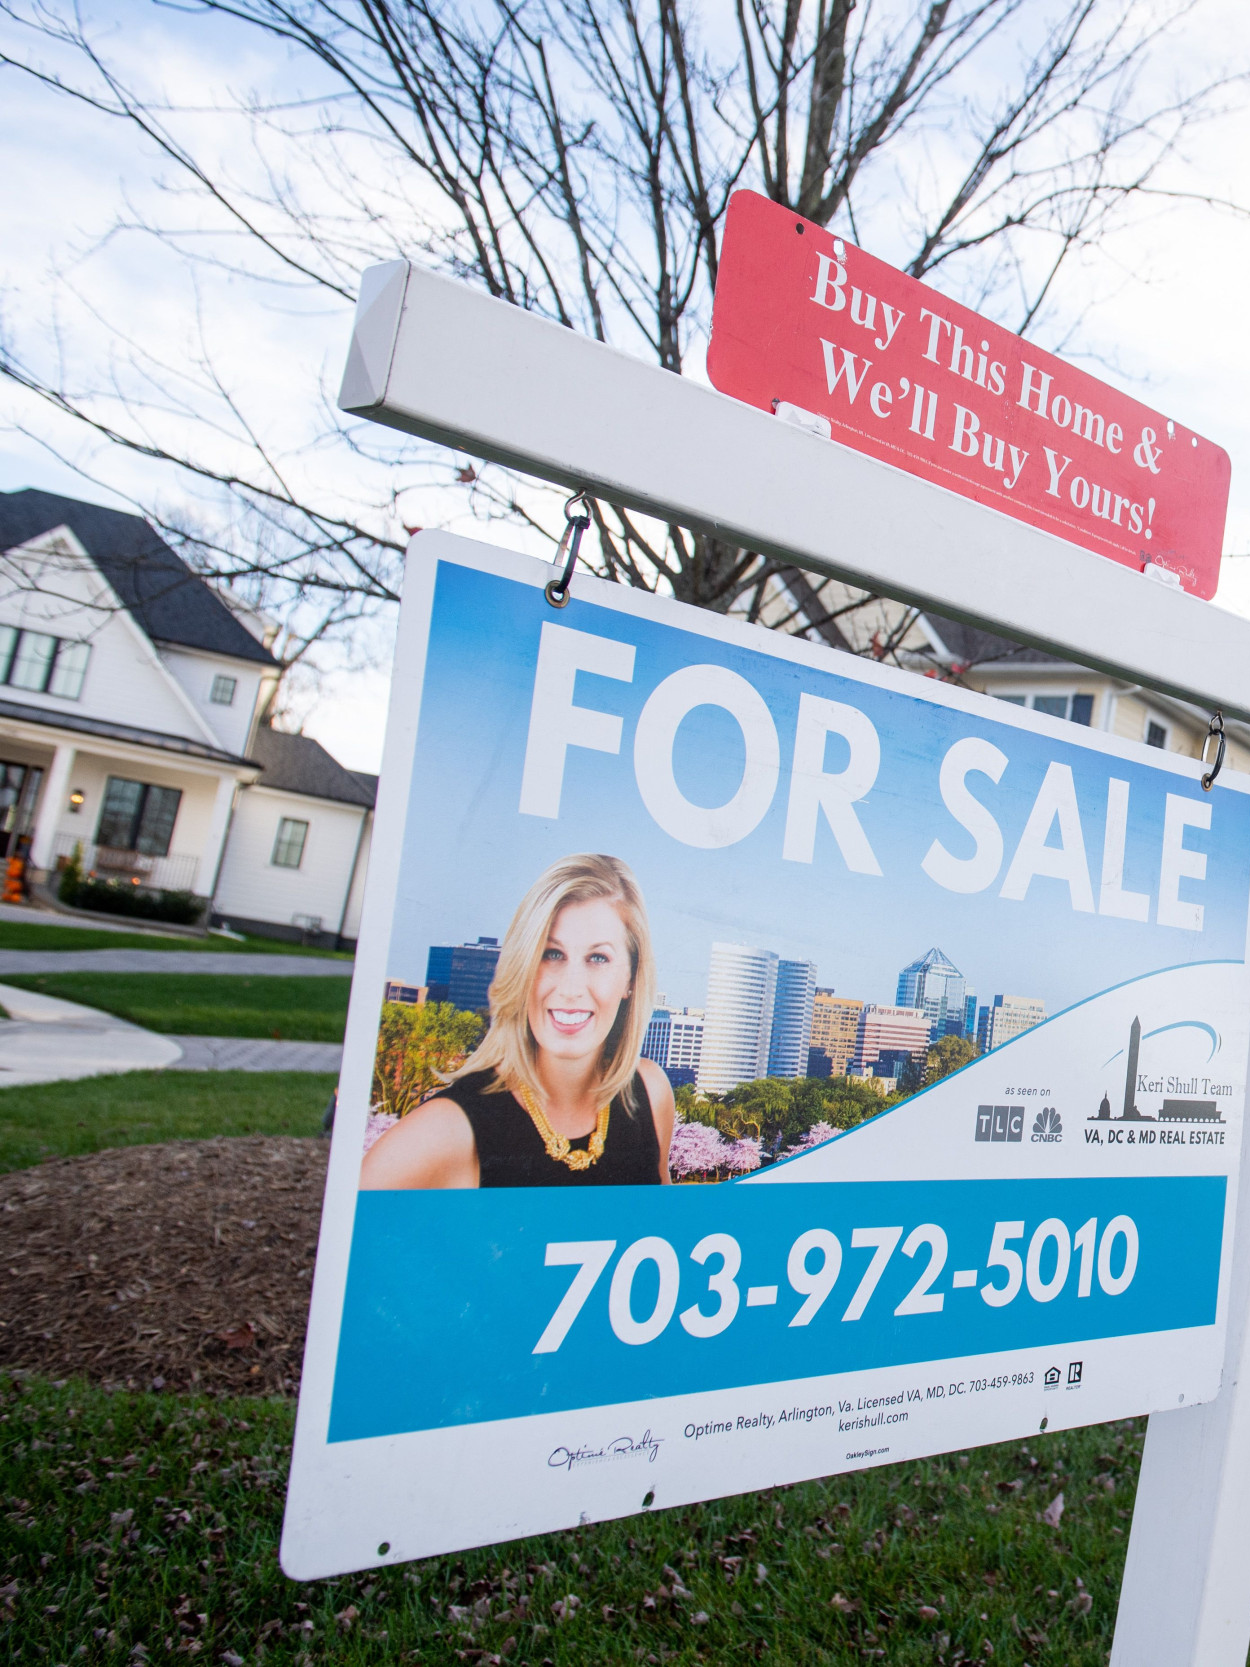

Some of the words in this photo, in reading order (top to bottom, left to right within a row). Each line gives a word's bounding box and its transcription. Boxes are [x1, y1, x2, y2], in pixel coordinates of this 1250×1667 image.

[810, 251, 905, 350] Buy
[920, 308, 1006, 395] This
[1016, 361, 1123, 453] Home
[1134, 427, 1163, 474] &
[820, 338, 937, 440] We'll
[948, 403, 1029, 489] Buy
[1043, 446, 1156, 540] Yours!
[519, 622, 883, 876] FOR
[921, 738, 1211, 931] SALE
[1005, 1086, 1015, 1095] as
[1017, 1087, 1038, 1096] seen
[1040, 1088, 1051, 1097] on
[1136, 1074, 1163, 1092] Keri
[1167, 1076, 1198, 1094] Shull
[1202, 1078, 1233, 1096] Team
[979, 1114, 1022, 1134] TLC
[1031, 1133, 1062, 1143] CNBC
[1084, 1129, 1104, 1146] VA,
[1108, 1129, 1124, 1144] DC
[1127, 1129, 1135, 1144] &
[1139, 1129, 1156, 1144] MD
[1160, 1130, 1185, 1144] REAL
[1189, 1131, 1225, 1145] ESTATE
[532, 1215, 1138, 1354] 703-972-5010
[684, 1421, 733, 1440] Optime
[737, 1412, 775, 1430] Realty,
[778, 1404, 835, 1423] Arlington,
[838, 1400, 855, 1413] Va.
[857, 1390, 904, 1411] Licensed
[907, 1389, 923, 1403] VA,
[926, 1386, 946, 1399] MD,
[948, 1382, 966, 1396] DC.
[969, 1372, 1034, 1393] 703-459-9863
[838, 1412, 909, 1432] kerishull.com
[548, 1444, 606, 1471] Optime
[607, 1429, 664, 1462] Realty
[845, 1447, 890, 1460] OakleySign.com
